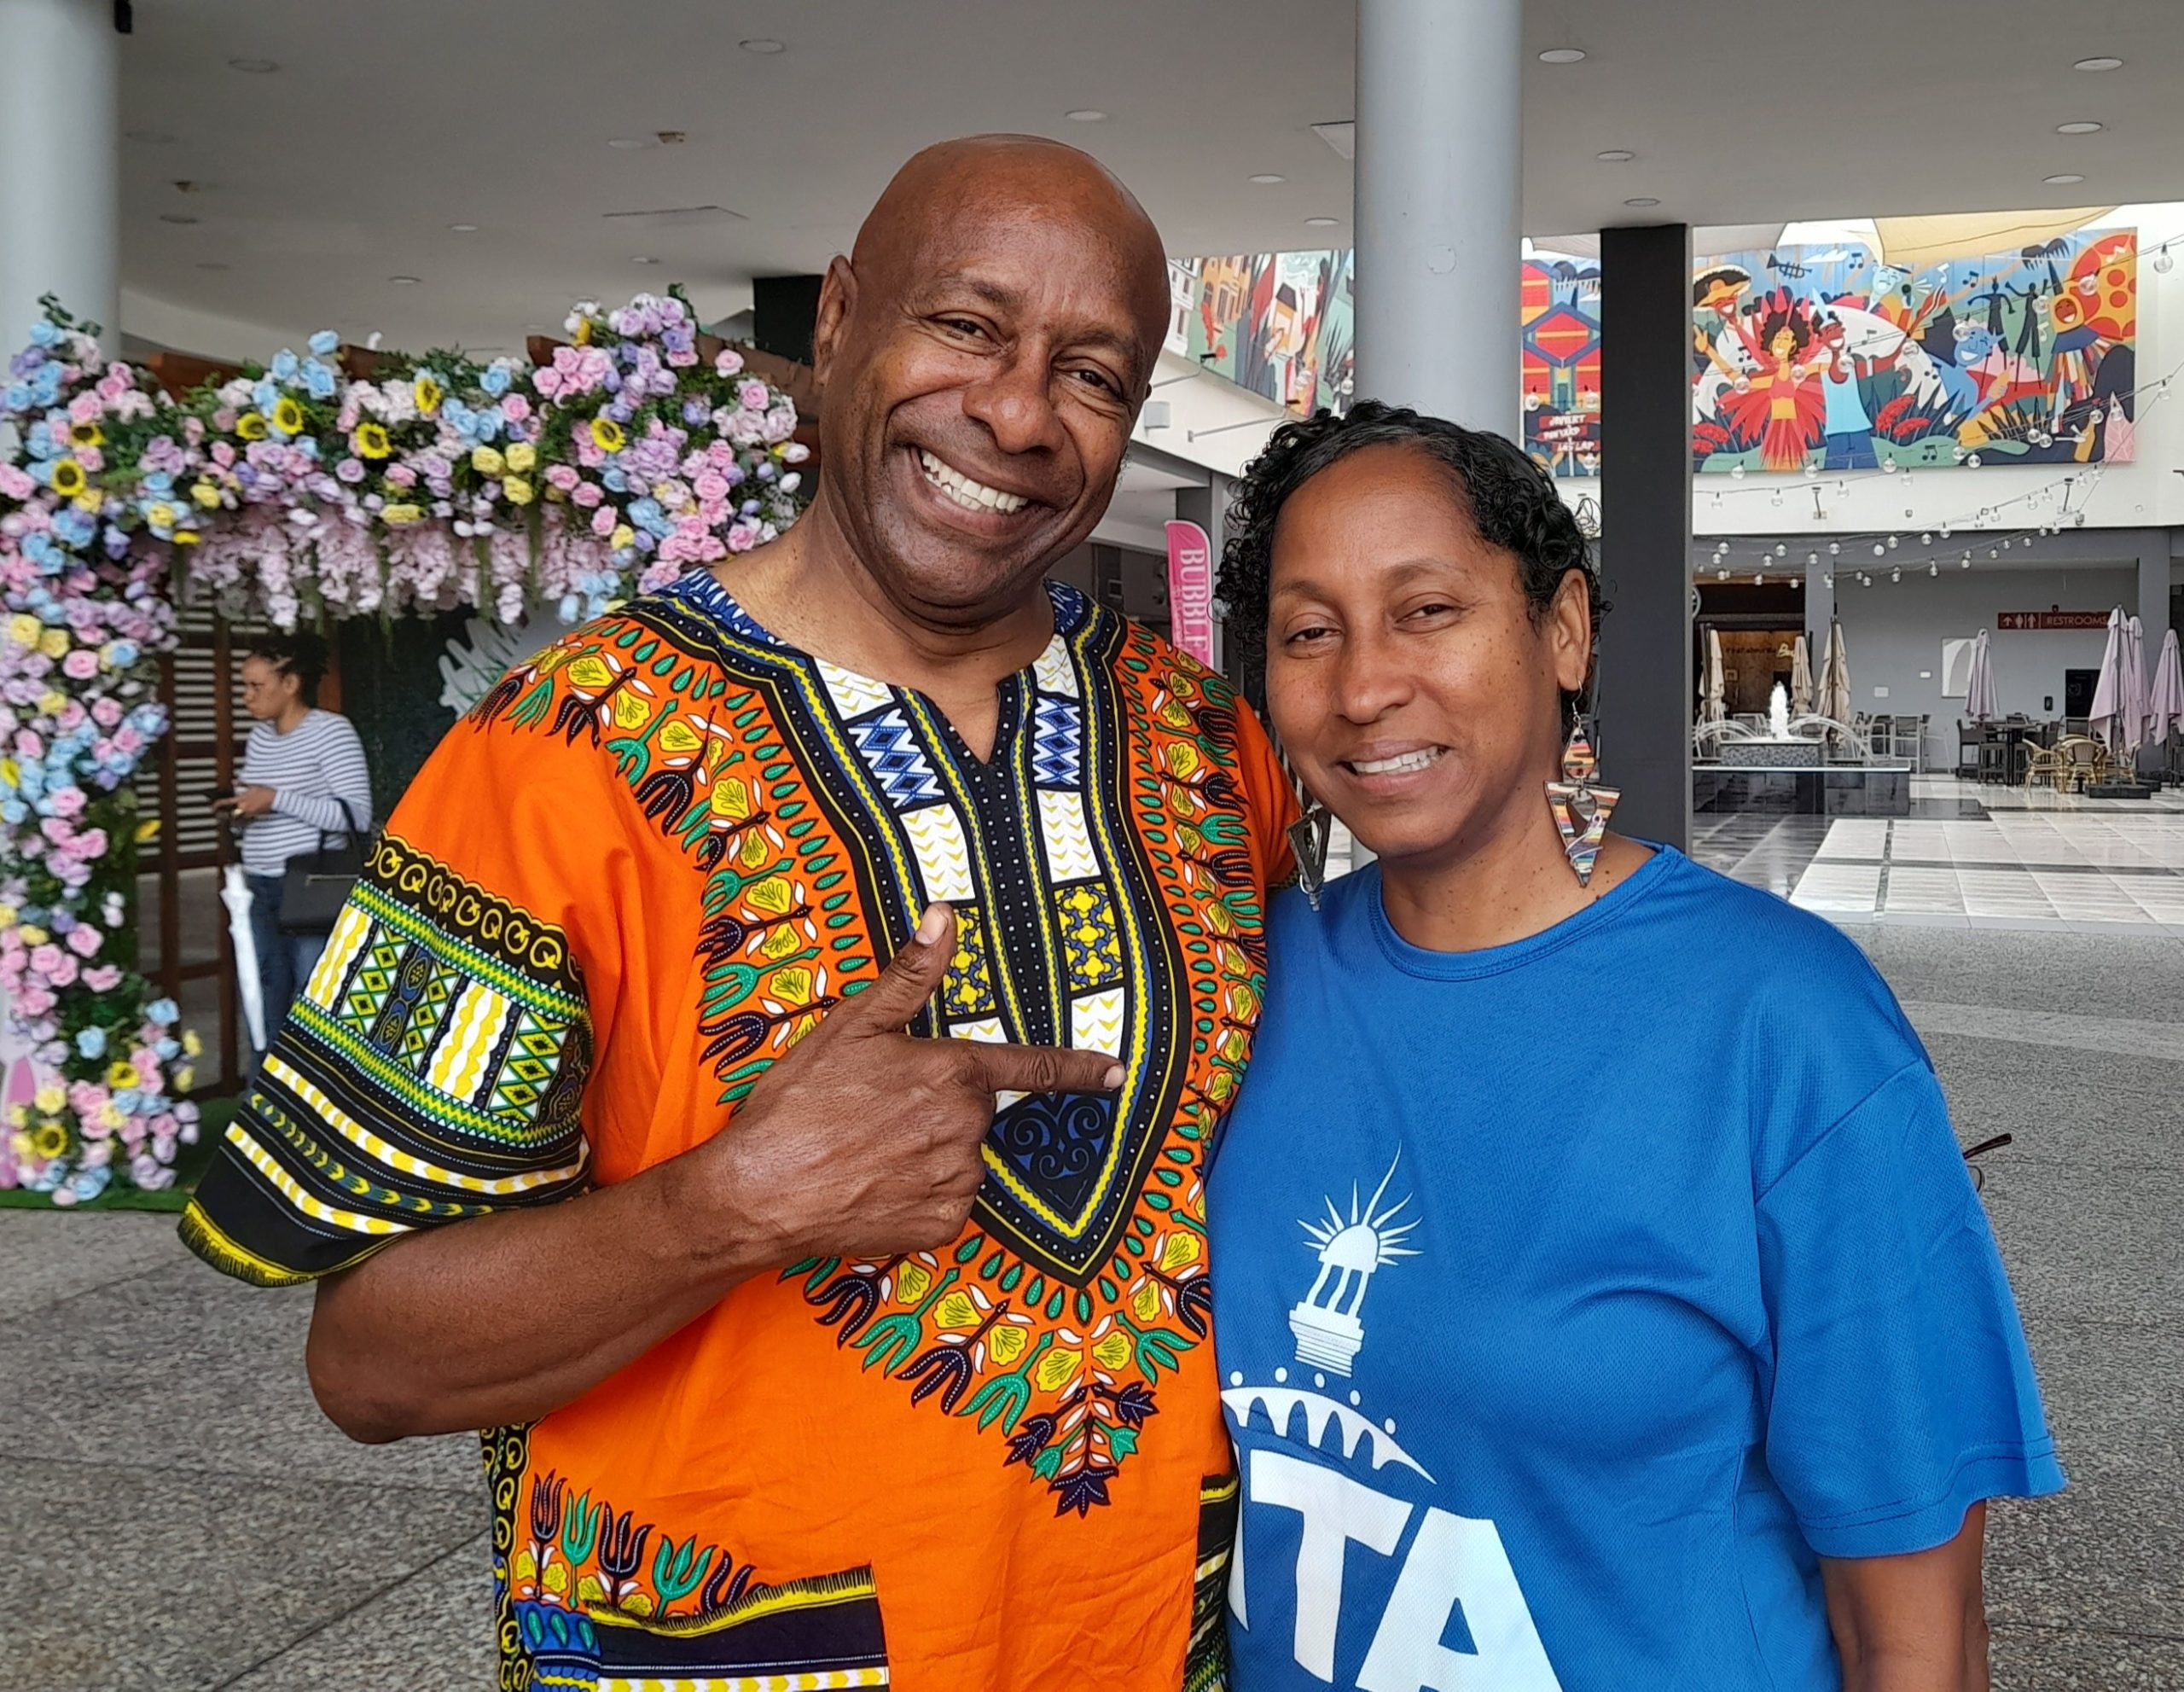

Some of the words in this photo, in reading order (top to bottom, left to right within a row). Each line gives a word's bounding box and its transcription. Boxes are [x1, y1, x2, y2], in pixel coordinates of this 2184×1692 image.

[1179, 547, 1208, 653] BUBBLE
[2048, 615, 2107, 625] RESTROOMS
[1227, 1442, 1562, 1692] TA
